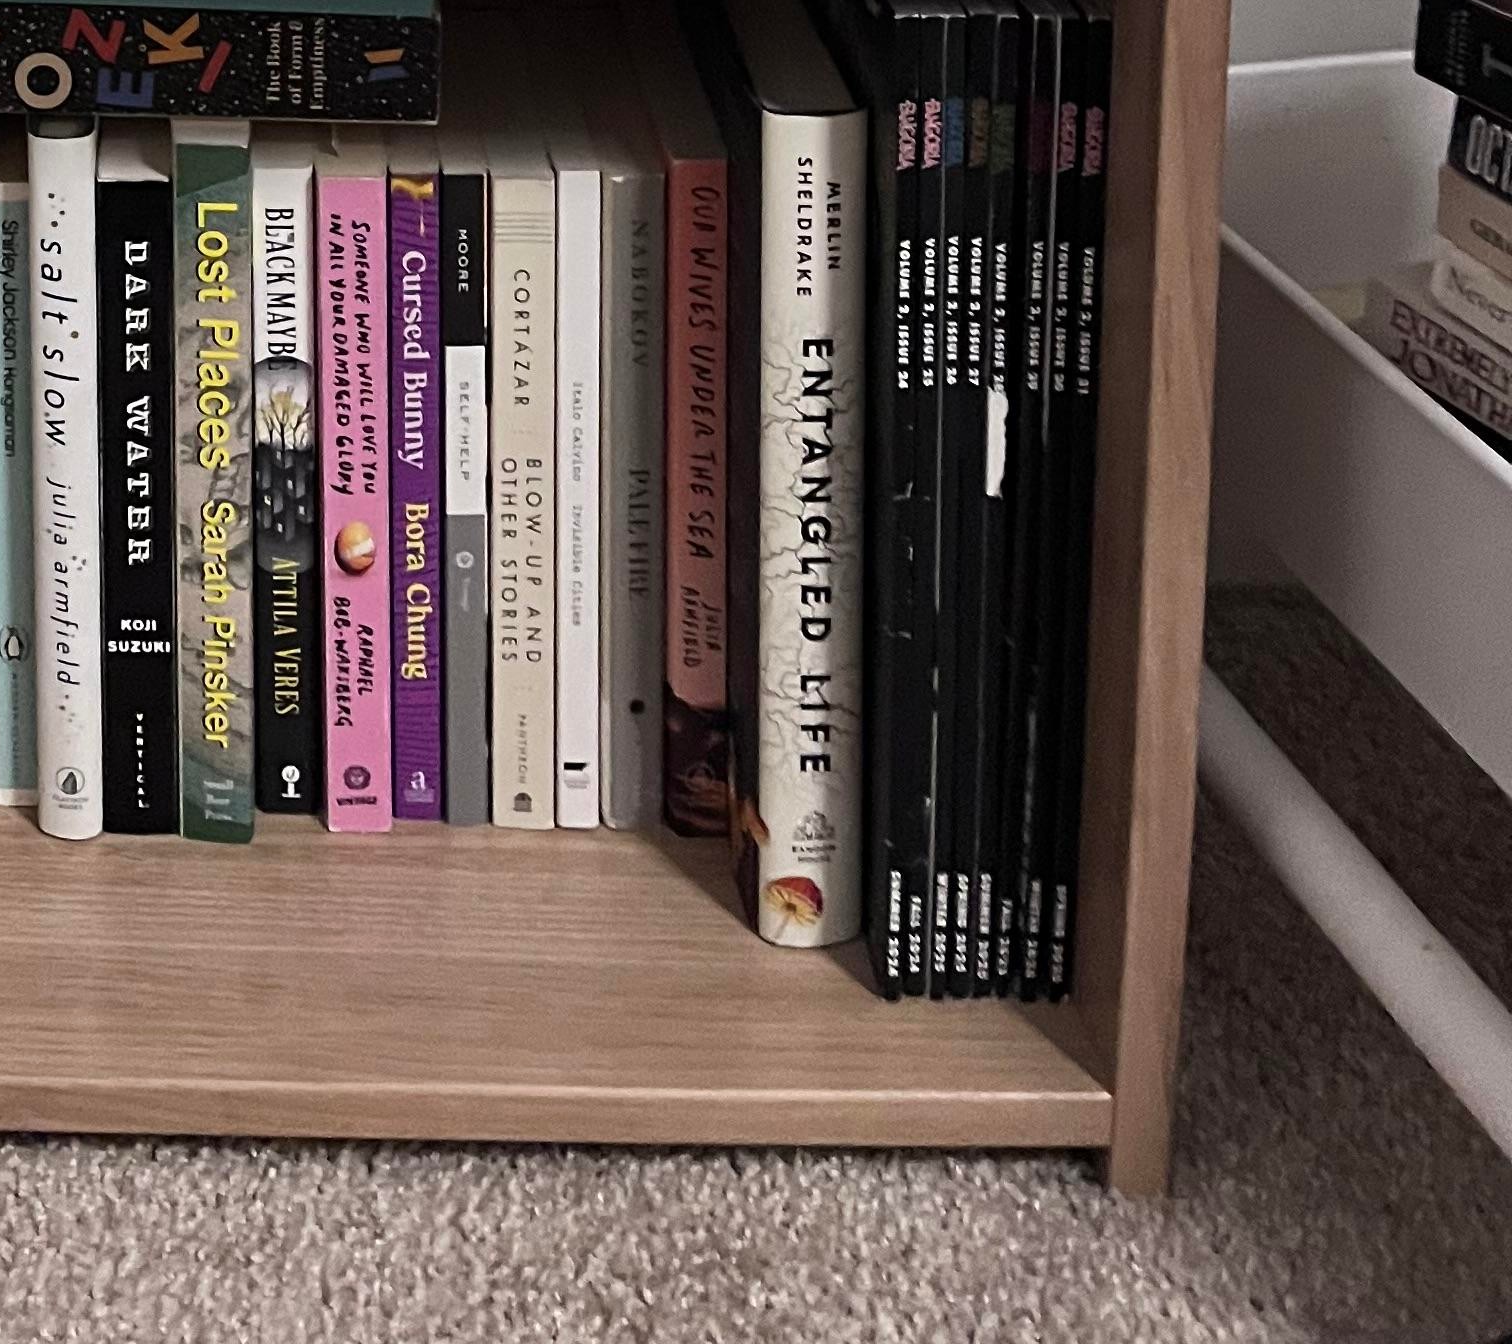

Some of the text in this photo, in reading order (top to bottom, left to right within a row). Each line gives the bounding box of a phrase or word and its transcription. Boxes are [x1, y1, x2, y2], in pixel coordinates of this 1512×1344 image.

[457, 229, 468, 292] MOORE
[796, 157, 813, 297] SHELDRAKE
[899, 240, 910, 299] VOLUME
[40, 240, 79, 686] salt slow julia armfield
[125, 241, 152, 565] DARK WATER
[197, 202, 240, 748] Lost Places Sarah Pinsker
[398, 250, 432, 680] Cursed Bunny Bora Chung
[108, 641, 171, 653] SUZUKI
[121, 619, 156, 632] KOJI
[800, 339, 834, 773] ENTANGLED LIFE
